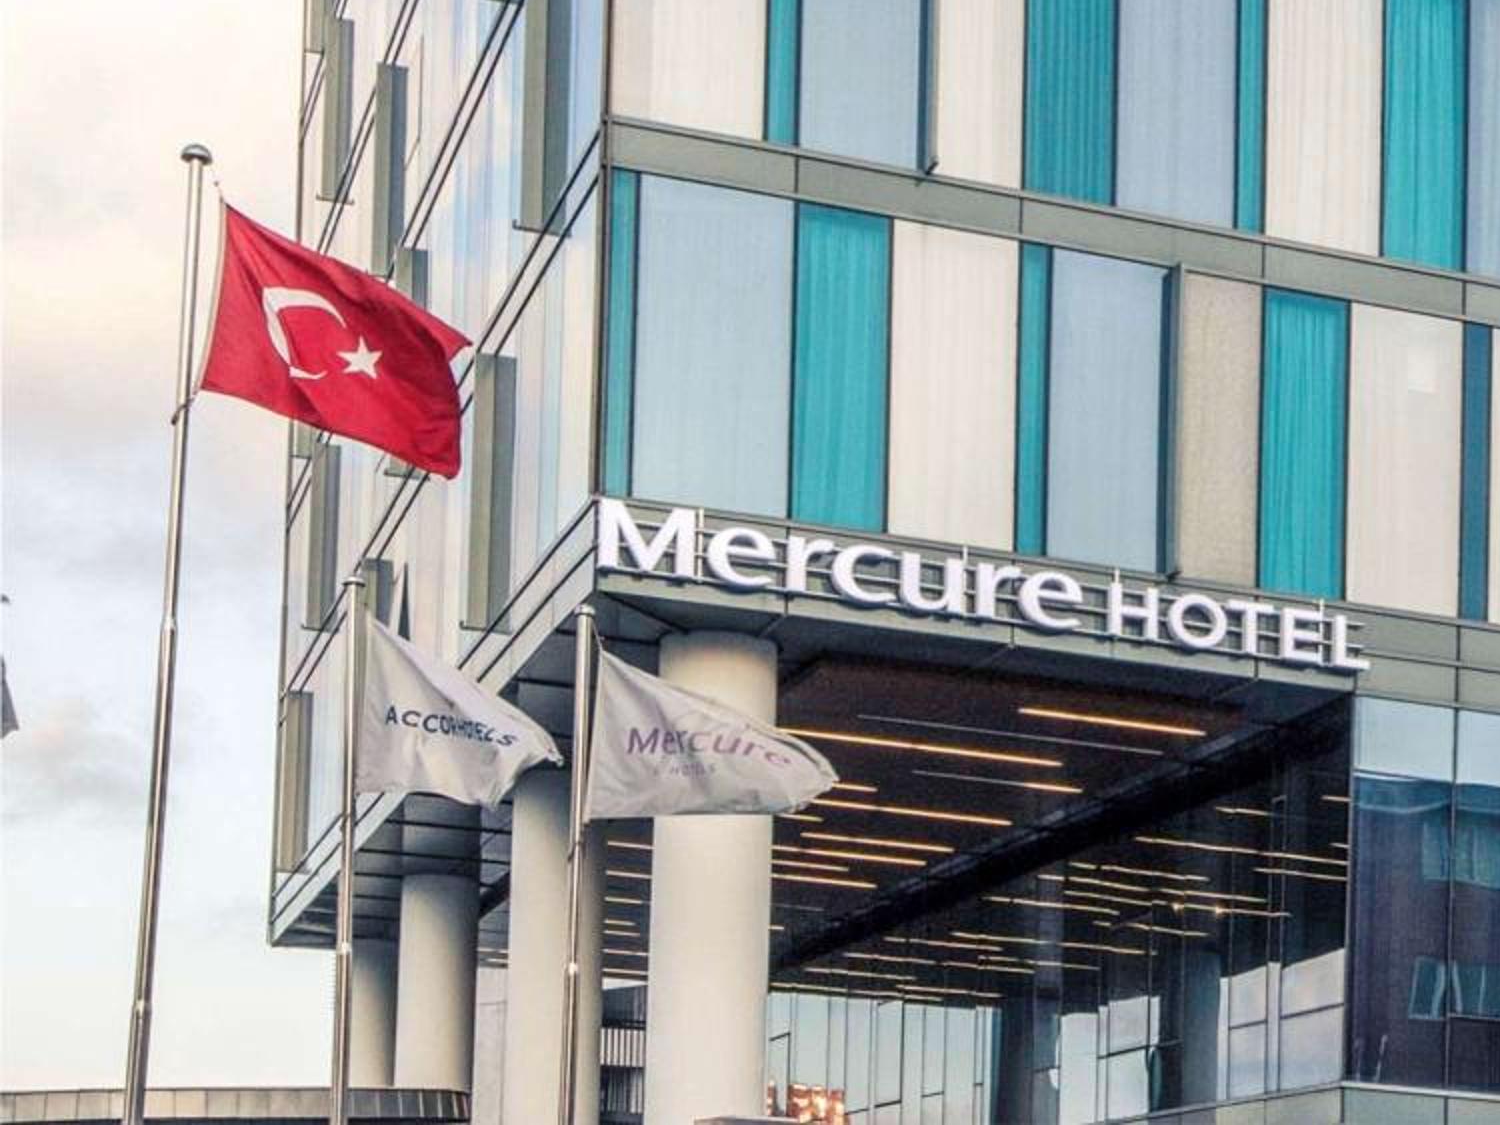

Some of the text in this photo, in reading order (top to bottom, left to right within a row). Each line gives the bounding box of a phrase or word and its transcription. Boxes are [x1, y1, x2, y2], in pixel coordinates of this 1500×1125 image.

[599, 497, 1371, 671] Mercure HOTEL
[384, 704, 519, 747] ACCORHELS
[627, 727, 792, 765] Mercure
